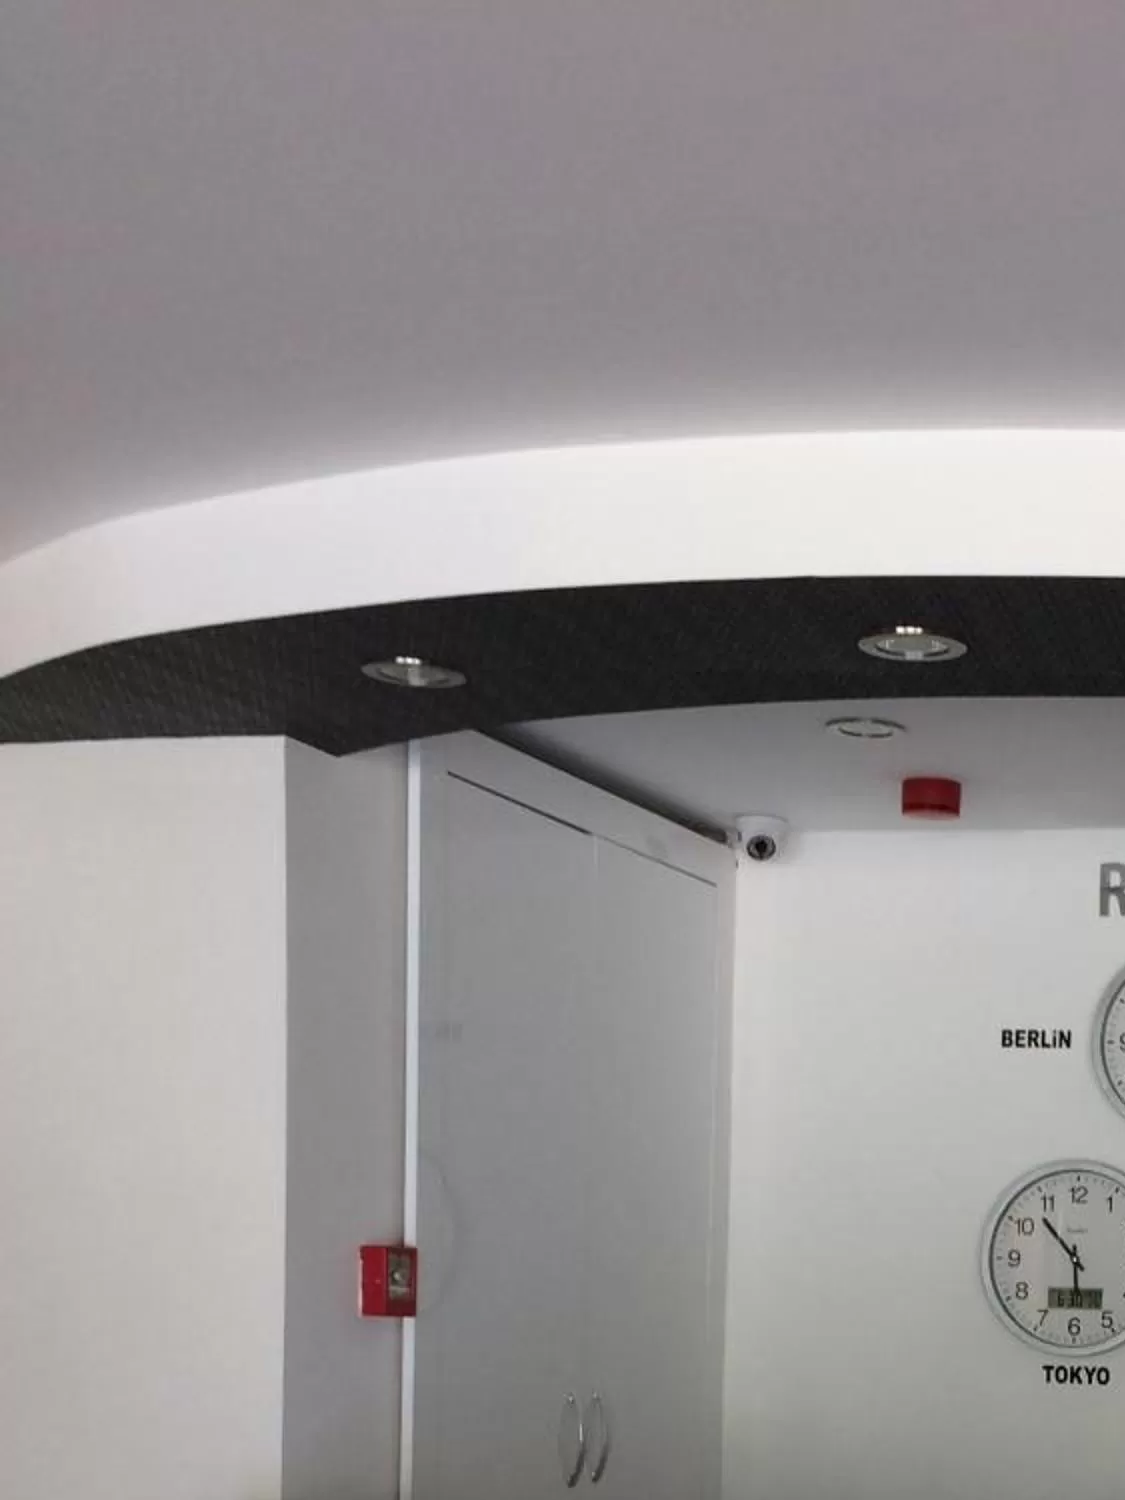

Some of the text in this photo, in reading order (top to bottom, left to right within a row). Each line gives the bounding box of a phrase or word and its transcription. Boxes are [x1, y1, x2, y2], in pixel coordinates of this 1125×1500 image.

[1041, 1195, 1054, 1212] 11
[1070, 1187, 1088, 1204] 12
[1107, 1196, 1113, 1212] 1
[1015, 1218, 1034, 1235] 10
[1008, 1250, 1021, 1267] 9
[1015, 1282, 1028, 1299] 8
[1038, 1310, 1049, 1326] 7
[1102, 1311, 1113, 1328] 5
[1068, 1318, 1080, 1336] 6
[1042, 1365, 1111, 1385] TOKYO
